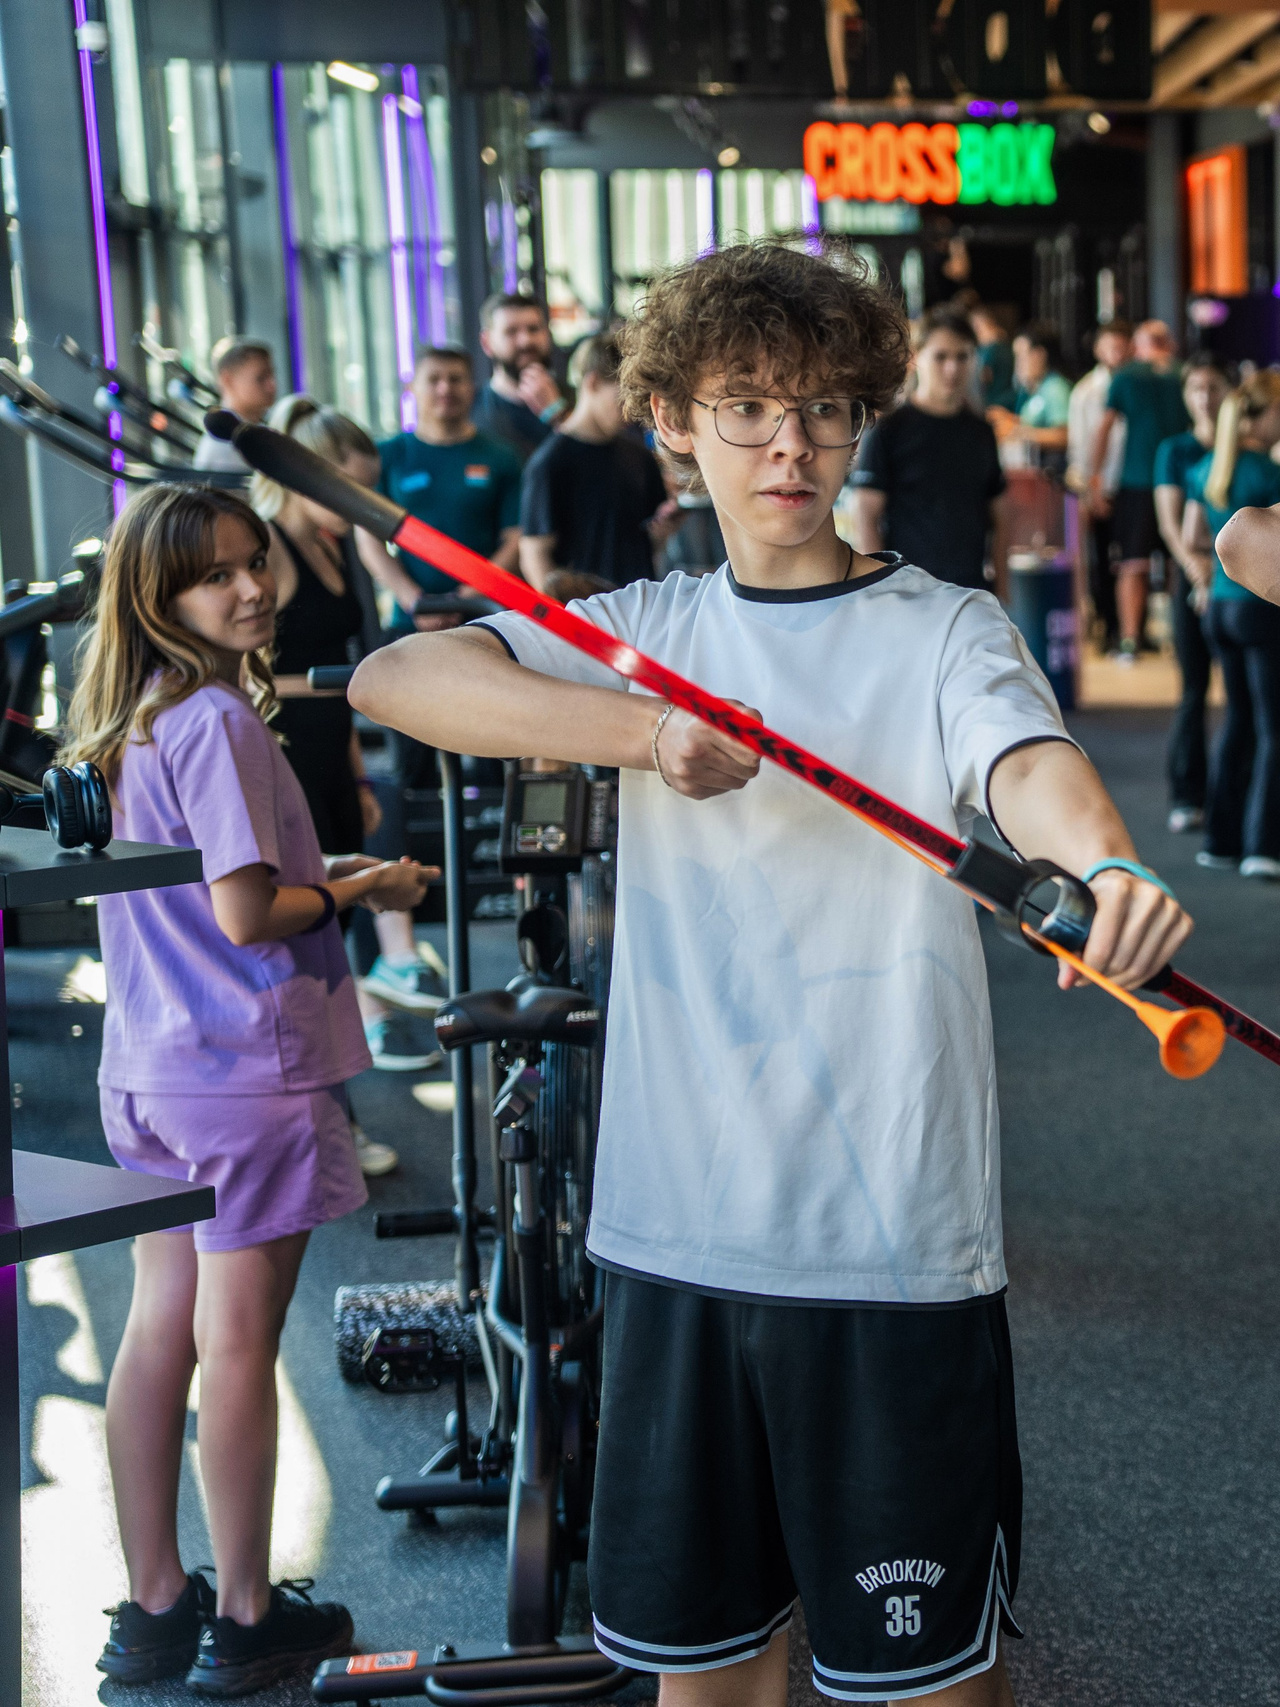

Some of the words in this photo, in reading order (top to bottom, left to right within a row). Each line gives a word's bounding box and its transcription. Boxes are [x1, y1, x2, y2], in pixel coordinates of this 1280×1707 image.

[803, 120, 1057, 206] CROSSBOX
[855, 1559, 946, 1594] BROOKLYN
[885, 1594, 922, 1637] 35
